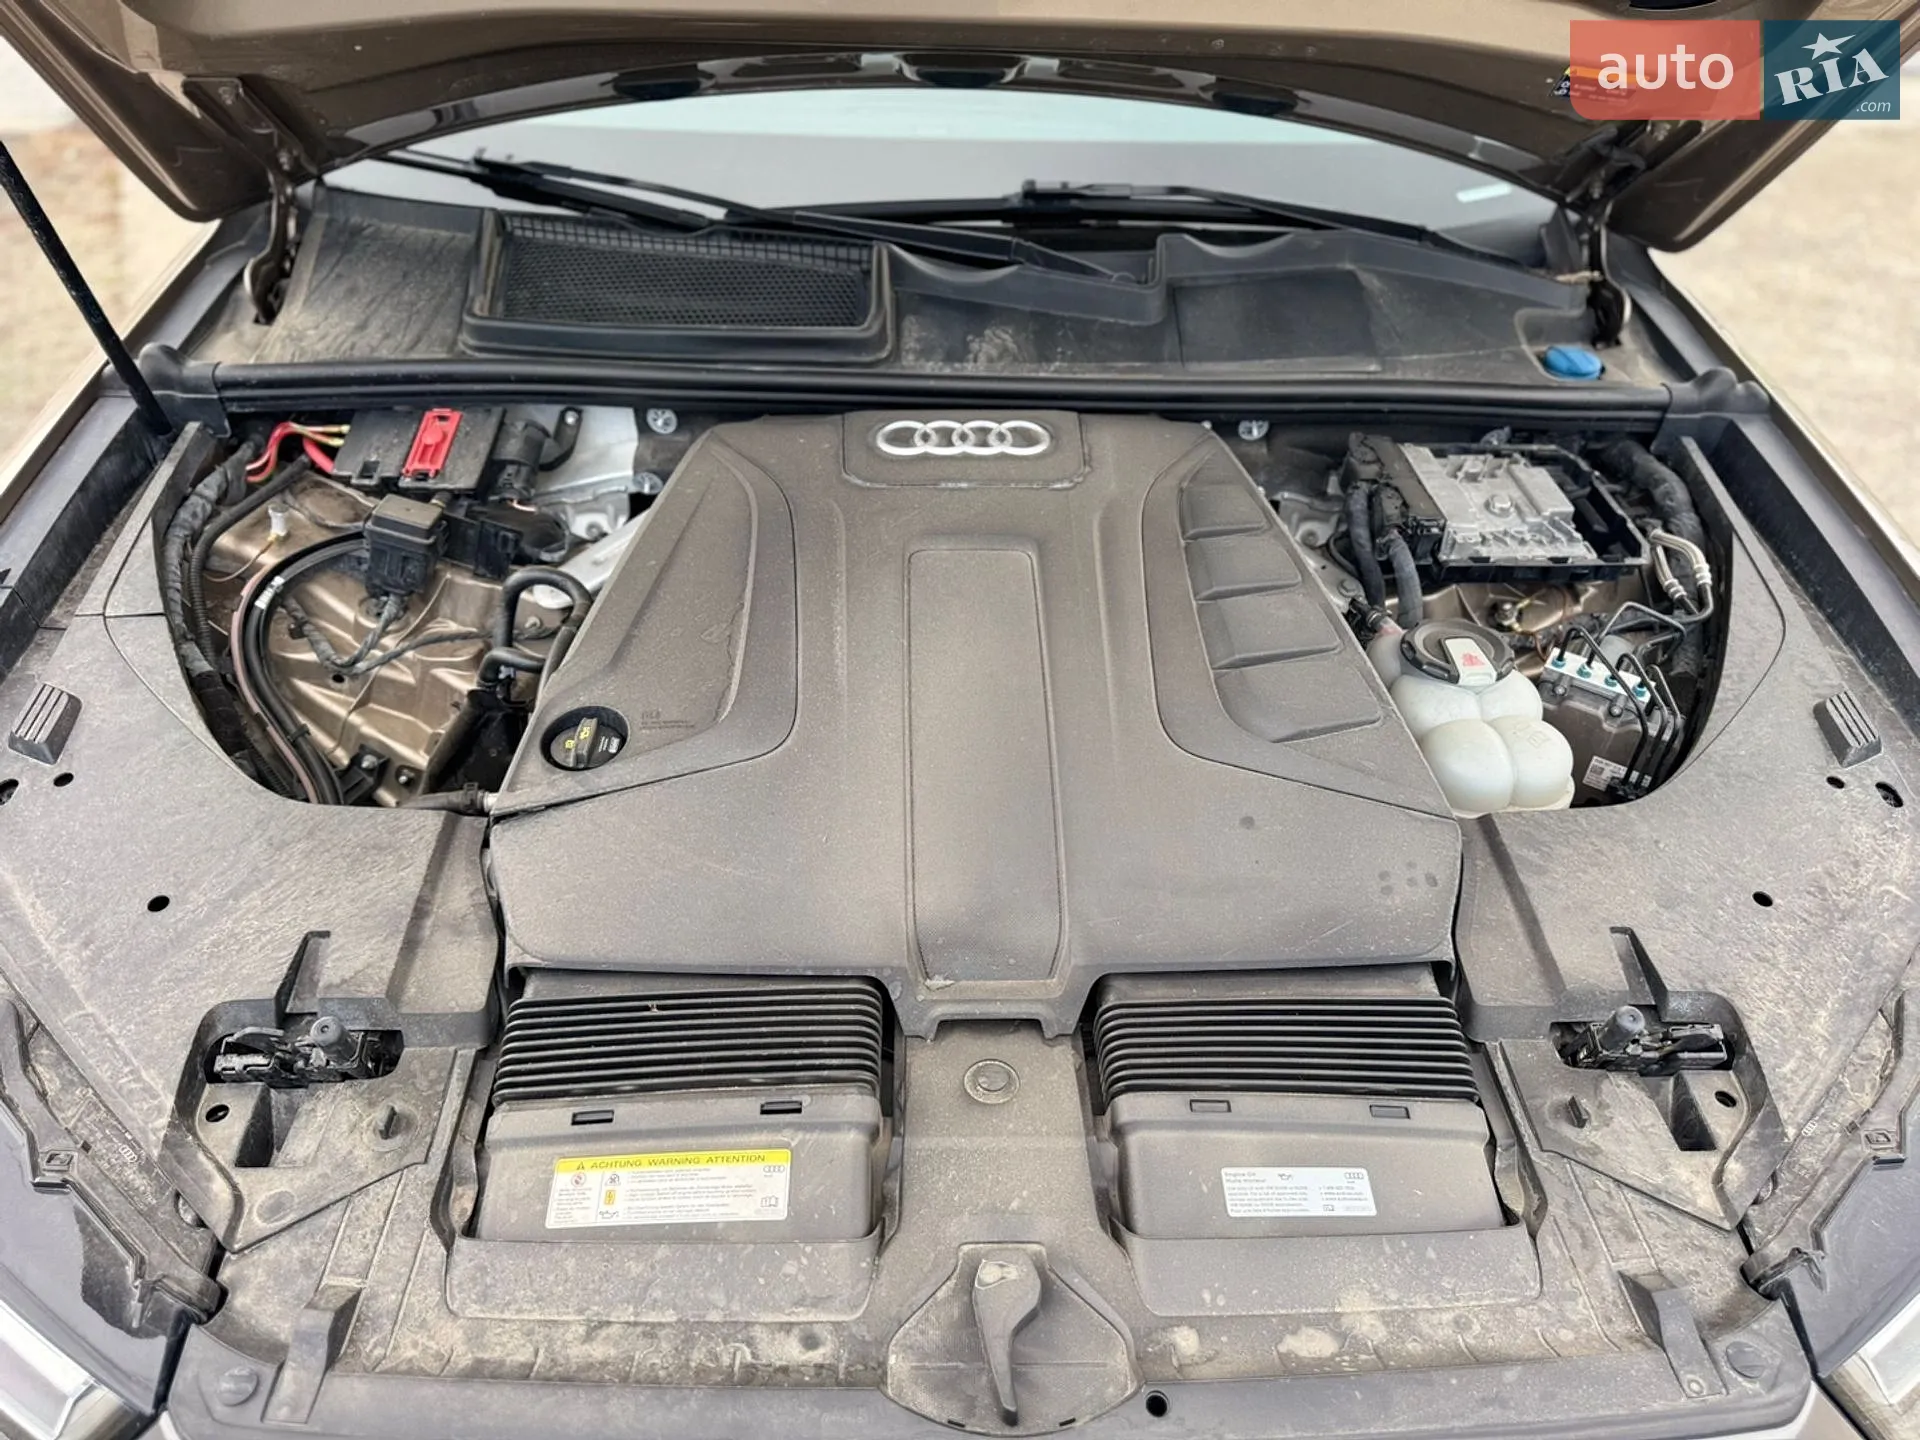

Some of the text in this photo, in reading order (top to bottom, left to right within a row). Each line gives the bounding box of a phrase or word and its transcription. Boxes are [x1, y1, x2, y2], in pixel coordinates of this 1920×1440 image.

[590, 1154, 766, 1169] ACHTUNG WARNING ATTENTION
